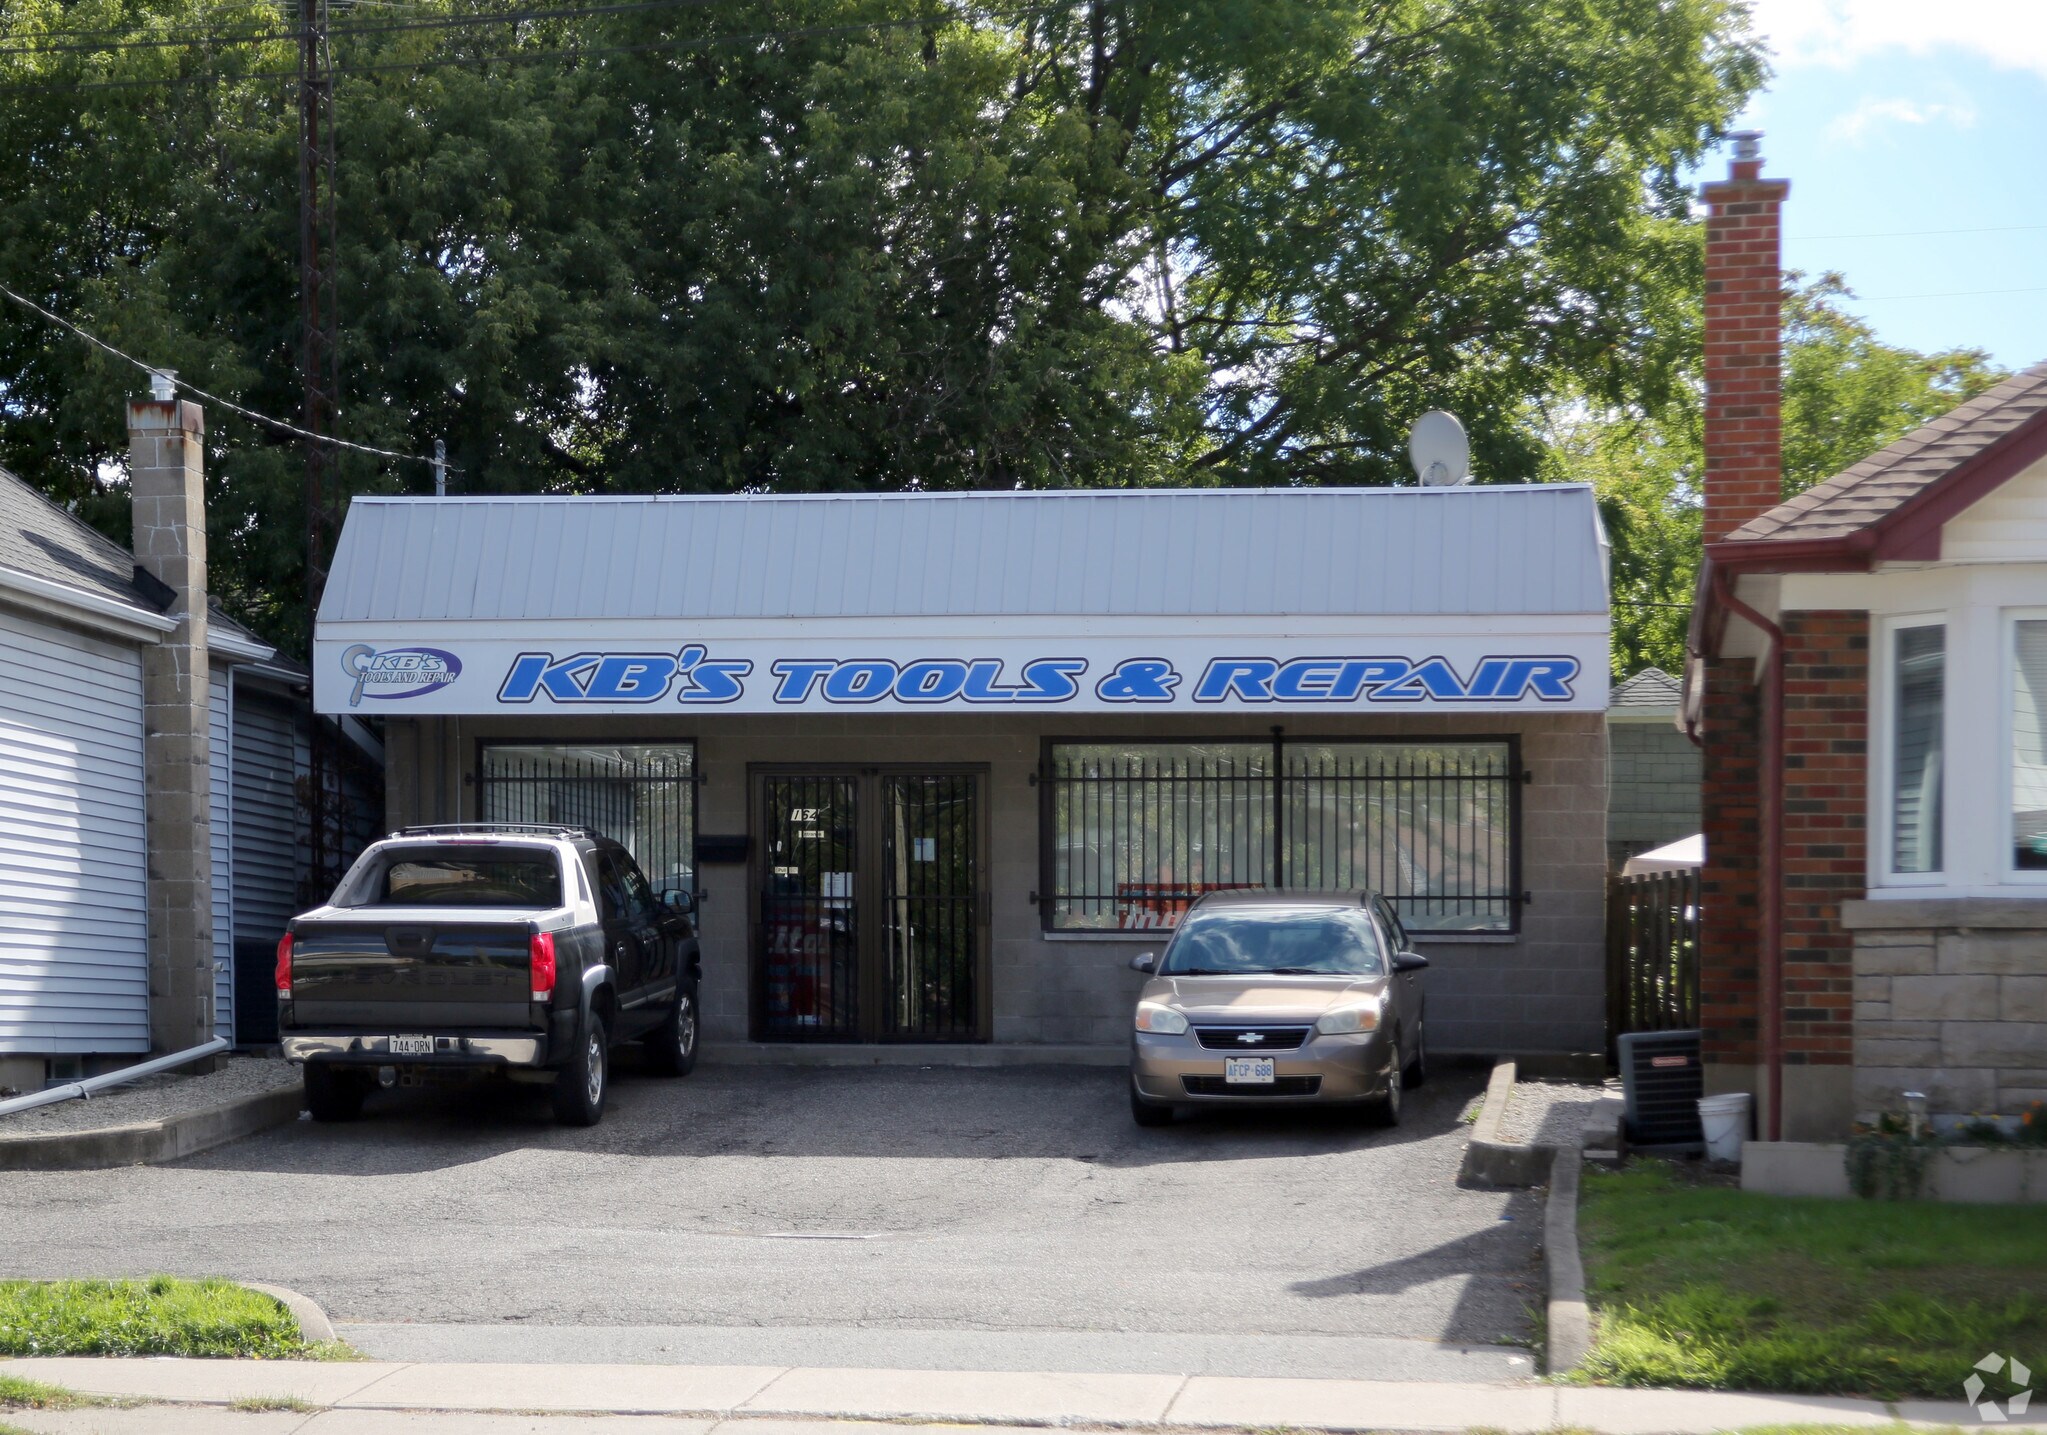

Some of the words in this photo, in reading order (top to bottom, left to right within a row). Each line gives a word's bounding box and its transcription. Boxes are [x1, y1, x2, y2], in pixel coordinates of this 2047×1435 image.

[371, 653, 443, 670] KB's
[359, 671, 394, 684] TOOLS
[391, 671, 419, 684] AND
[418, 671, 457, 684] REPAIR
[497, 644, 754, 704] KB's
[771, 657, 1088, 703] TOOLS
[1095, 656, 1182, 703] &
[1191, 655, 1581, 702] REPAIR
